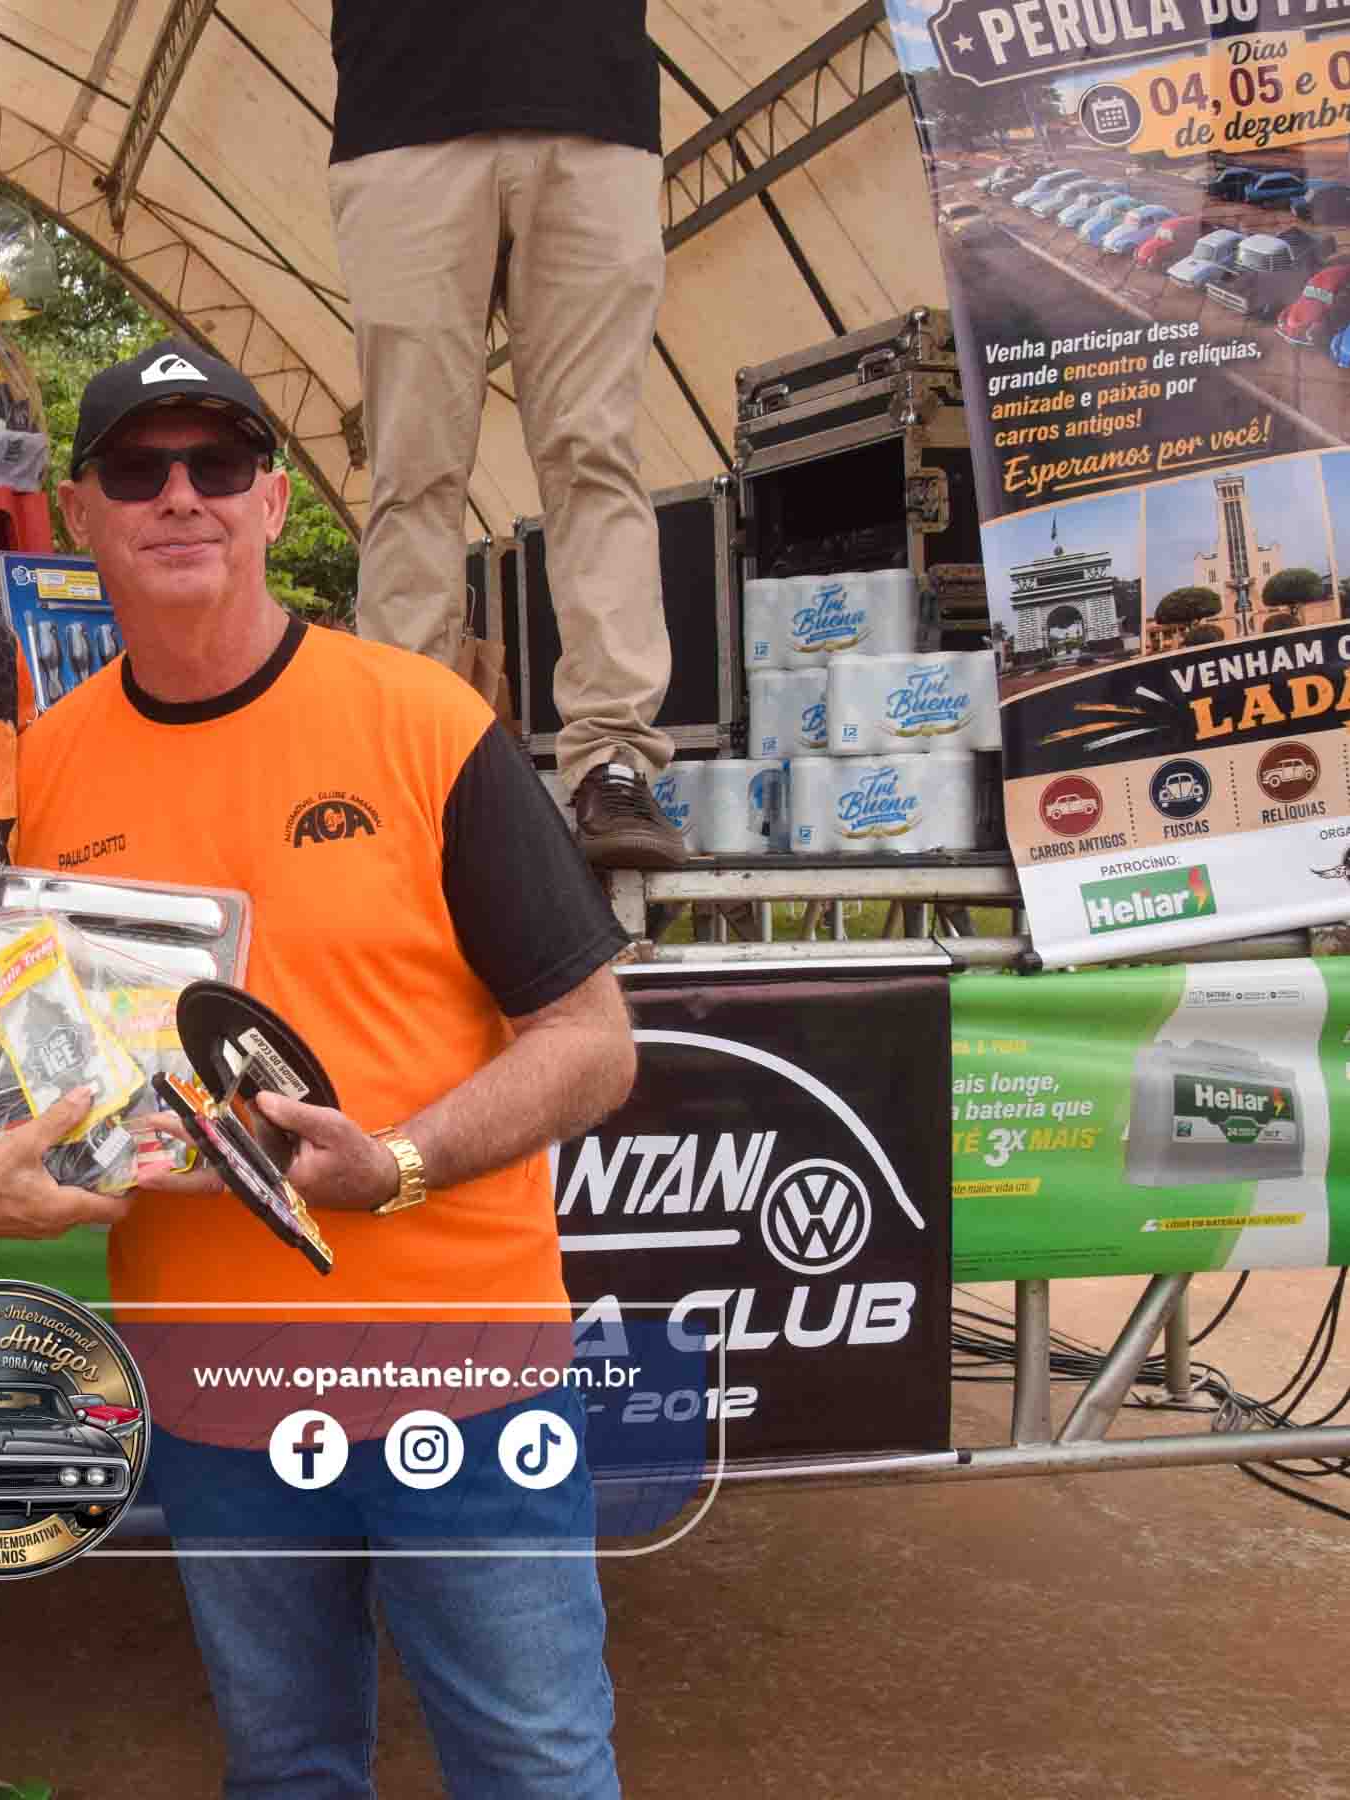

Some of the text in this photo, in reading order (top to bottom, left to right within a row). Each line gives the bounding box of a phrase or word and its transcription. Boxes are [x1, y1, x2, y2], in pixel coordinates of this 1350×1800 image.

[1227, 38, 1289, 65] Dias
[1229, 65, 1283, 107] 05
[1296, 71, 1317, 95] e
[1175, 117, 1215, 148] de
[985, 319, 1199, 364] Venha participar desse
[988, 365, 1058, 396] grande
[1063, 355, 1148, 382] encontro
[1152, 351, 1176, 370] de
[991, 377, 1197, 420] amizade e paixão por
[994, 408, 1143, 448] carros antigos!
[1002, 415, 1273, 498] Esperamos por você!
[813, 587, 848, 616] Tri
[793, 607, 866, 636] Buena
[1170, 640, 1324, 693] VENHAM
[908, 672, 949, 698] Tri
[887, 689, 970, 719] Buena
[842, 727, 858, 737] 12
[860, 772, 896, 799] Tri
[838, 790, 916, 821] Buena
[1262, 800, 1327, 824] RELÍQUIAS
[1163, 819, 1210, 839] FUSCAS
[58, 833, 125, 867] PAULO CATTO
[1030, 833, 1127, 861] CARROS ANTIGOS
[1100, 855, 1181, 878] PATROCÍNIO:
[1086, 886, 1189, 928] Heliar
[952, 1072, 1059, 1096] ais longe,
[1194, 1083, 1269, 1112] Heliar
[966, 1097, 1093, 1122] bateria que
[952, 1124, 982, 1153] TÉ
[550, 1131, 778, 1215] NTANI
[666, 1281, 917, 1352] CLUB
[622, 1385, 759, 1424] 2012
